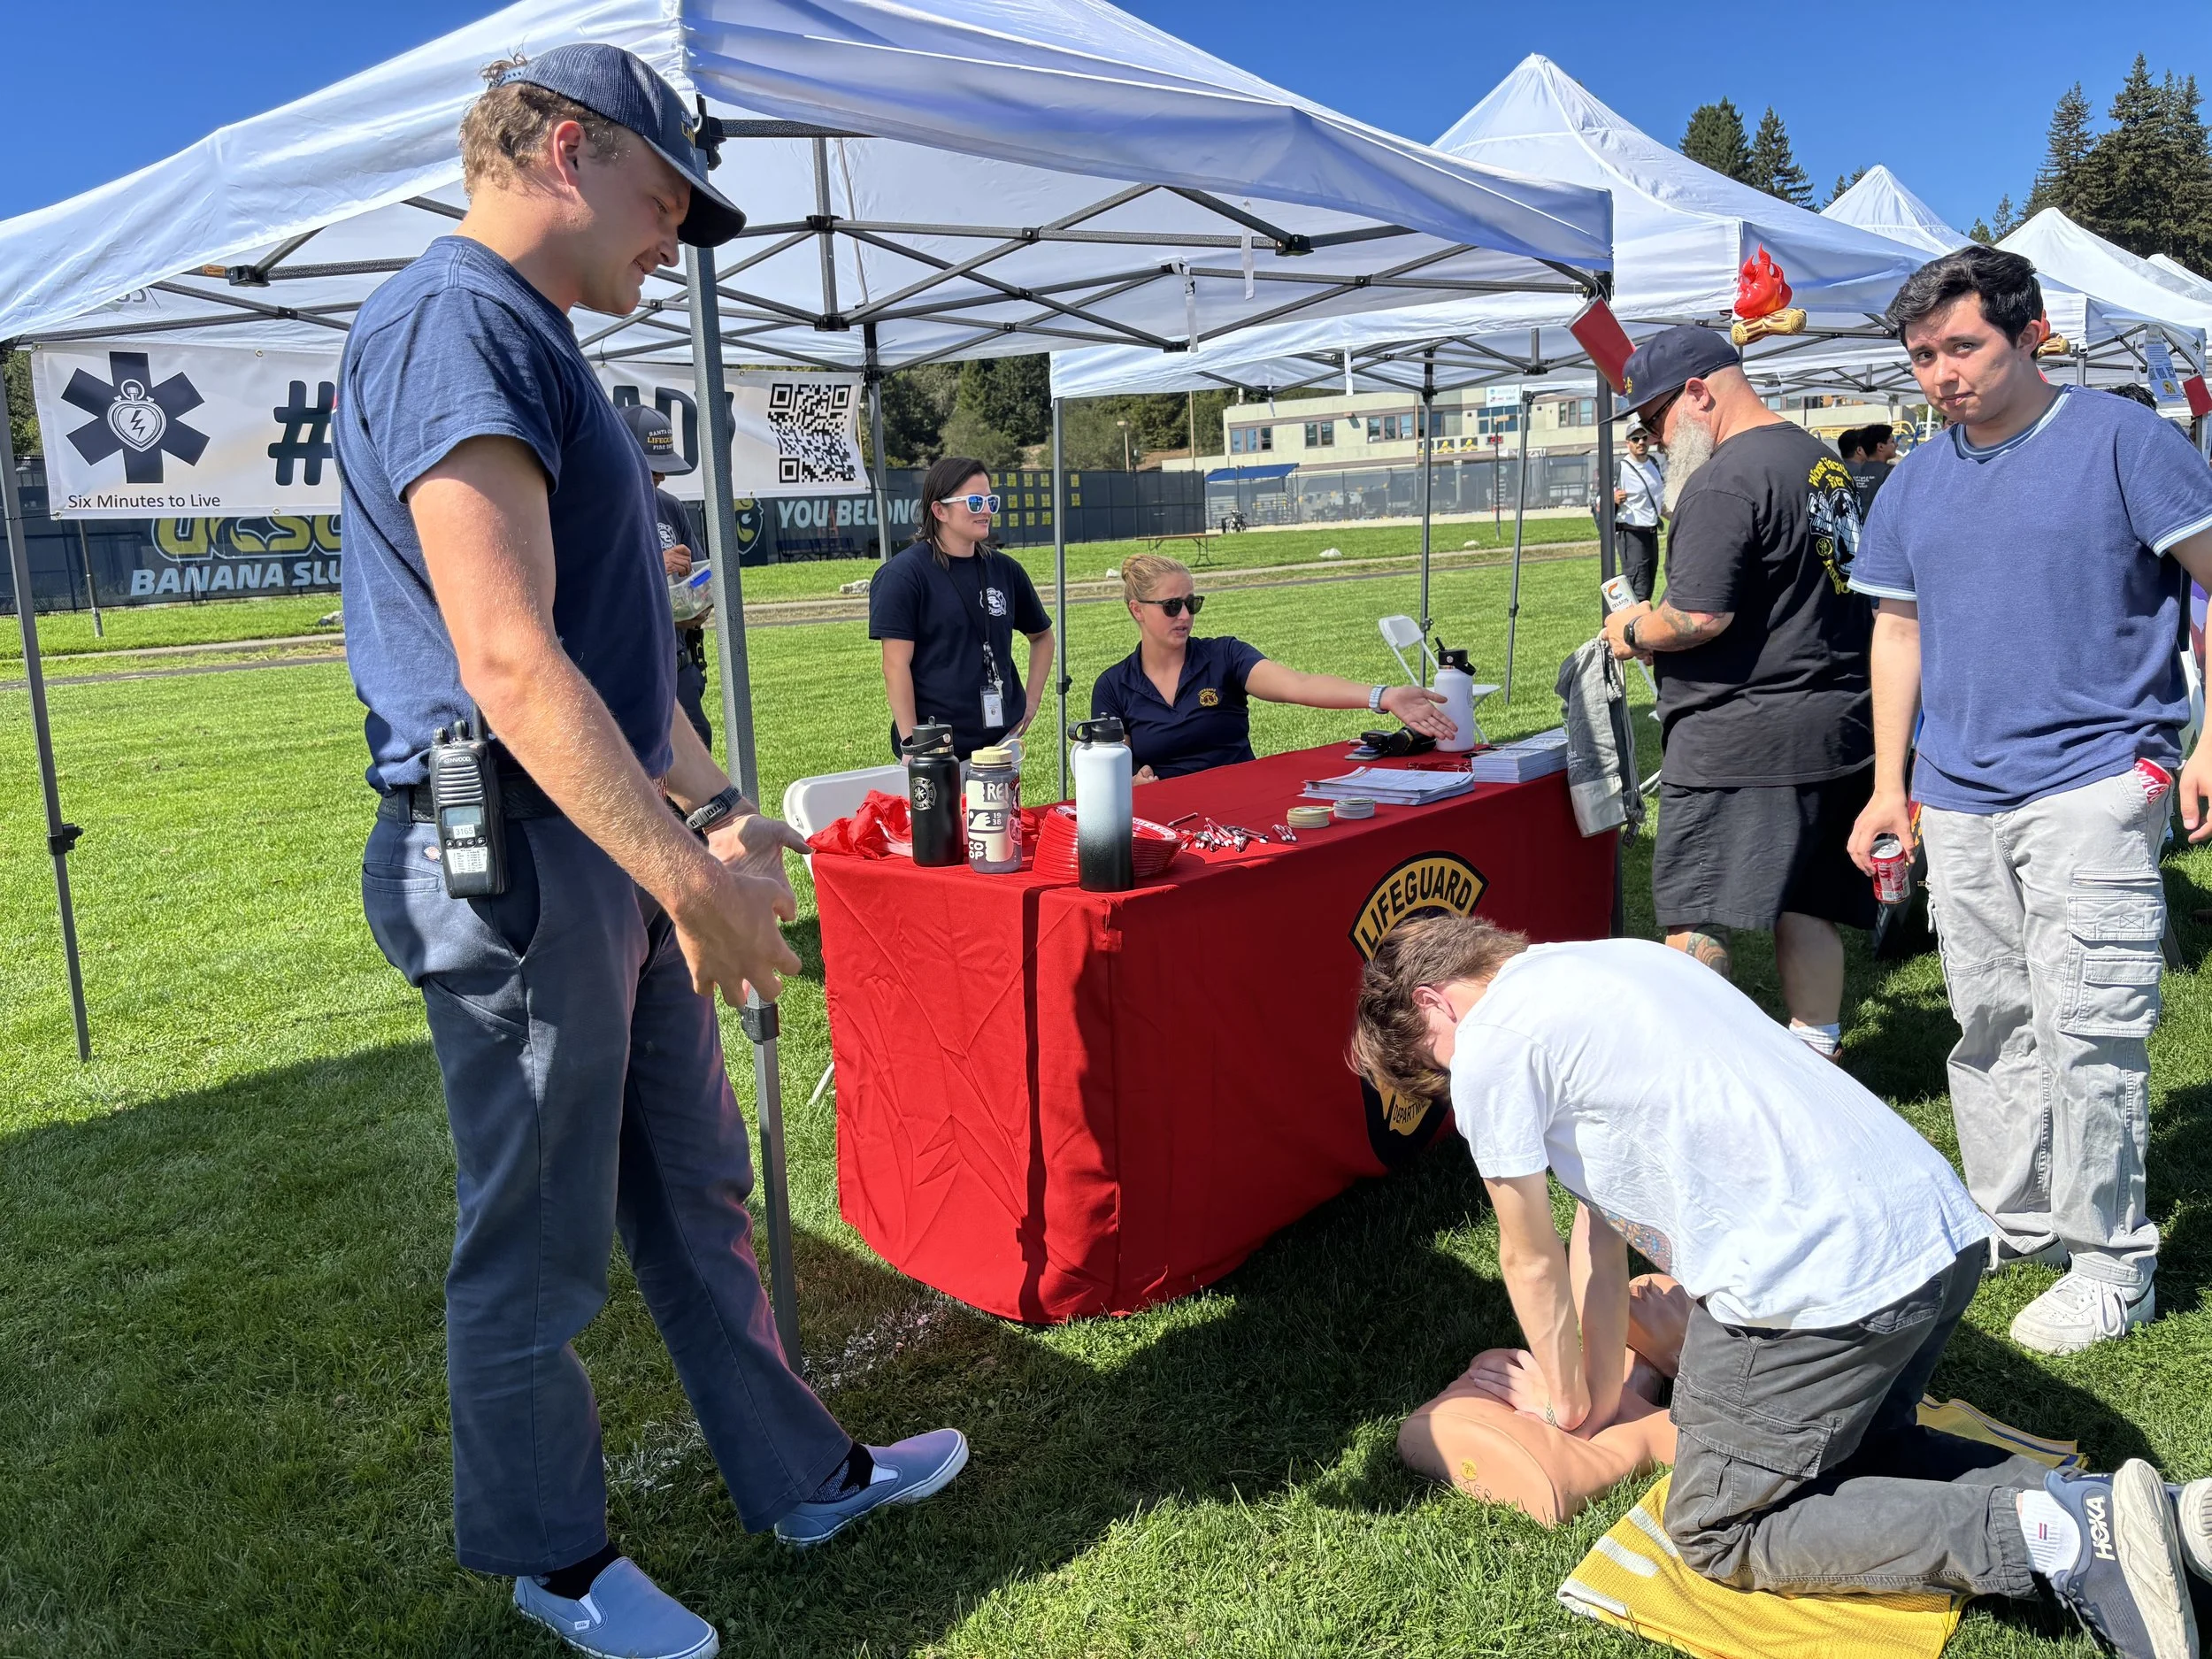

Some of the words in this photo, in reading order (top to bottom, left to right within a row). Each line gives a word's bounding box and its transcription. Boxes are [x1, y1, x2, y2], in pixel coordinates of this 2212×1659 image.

[68, 495, 92, 509] Six
[97, 495, 164, 508] Minutes
[168, 495, 186, 507] to
[191, 494, 220, 507] Live
[778, 499, 829, 528] YOU
[130, 563, 285, 596] BANANA
[292, 560, 342, 586] SLU
[455, 826, 473, 836] 3165
[969, 841, 984, 851] CO
[969, 850, 984, 860] OP
[1360, 865, 1472, 953] LIFEGUARD
[1393, 1101, 1426, 1125] DEPARTM
[2085, 1494, 2116, 1561] HOKA
